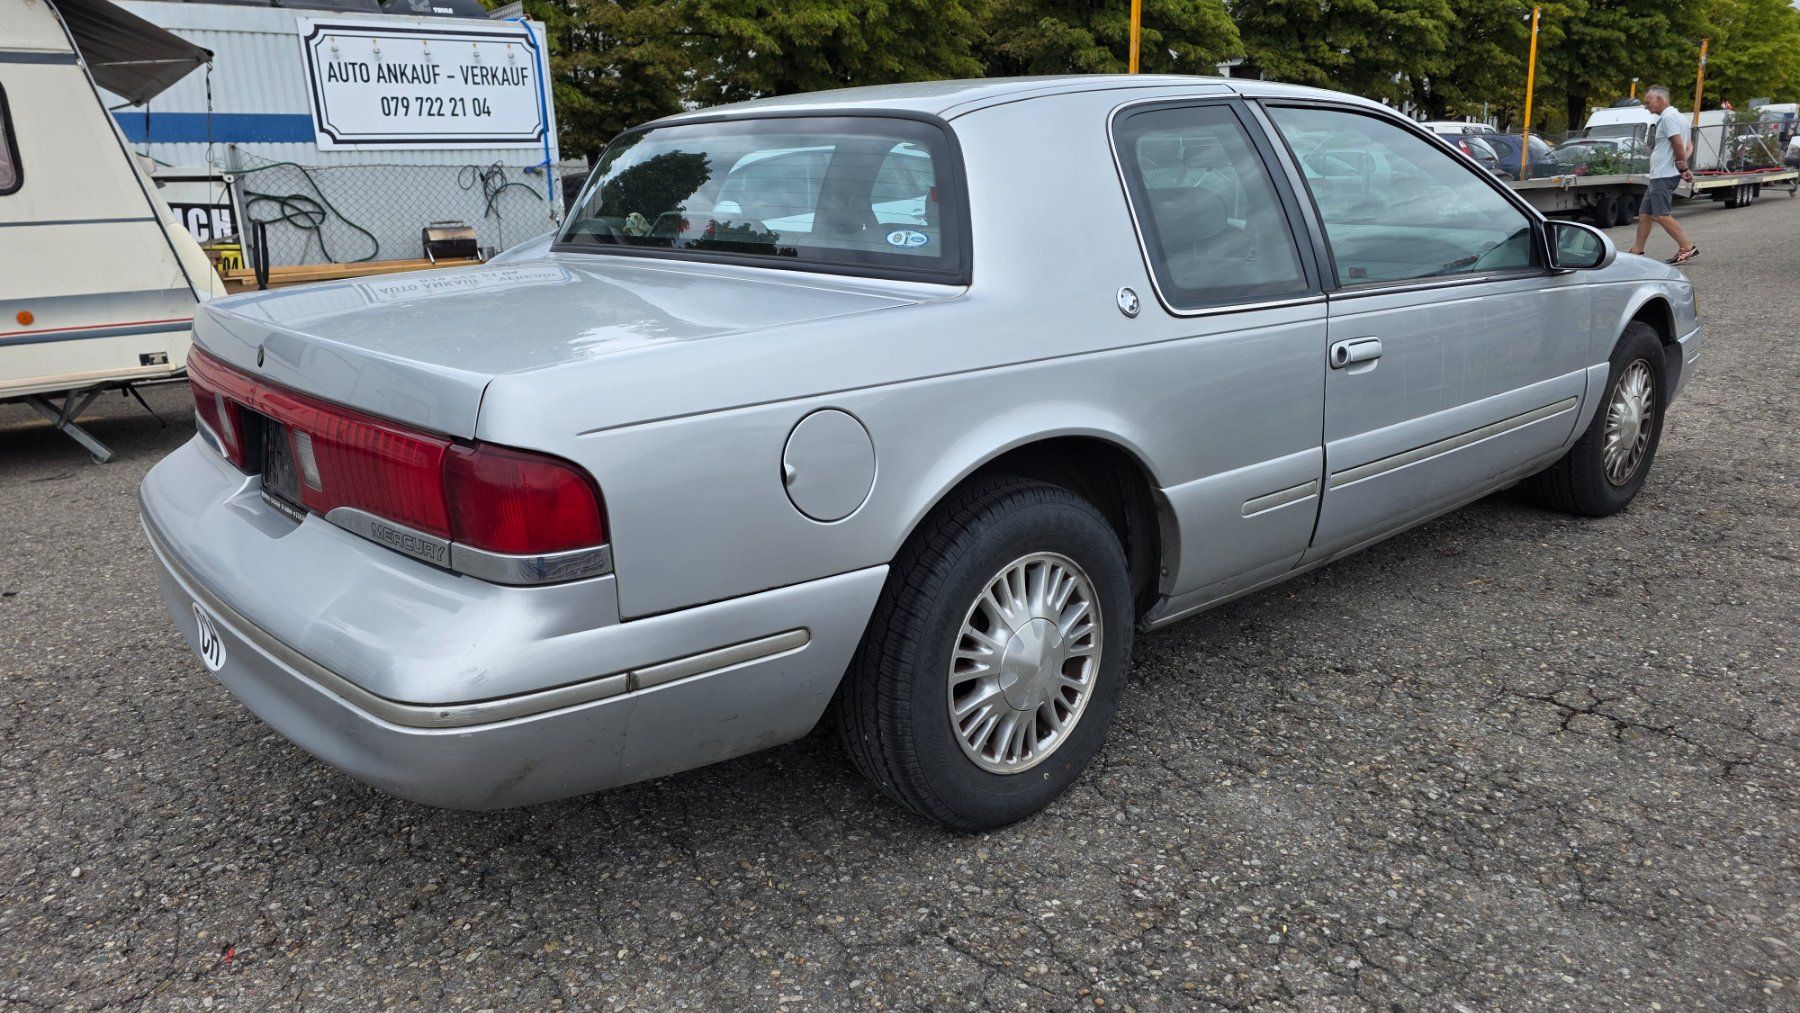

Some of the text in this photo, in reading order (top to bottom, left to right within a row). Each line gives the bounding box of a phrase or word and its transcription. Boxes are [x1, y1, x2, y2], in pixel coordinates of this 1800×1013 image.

[432, 6, 454, 15] THULE
[327, 61, 371, 83] AUTO
[376, 63, 440, 85] ANKAUF
[460, 65, 529, 87] VERKAUF
[381, 96, 492, 117] 079 722 21 04
[371, 522, 446, 562] MERCURY
[194, 606, 221, 668] CH
